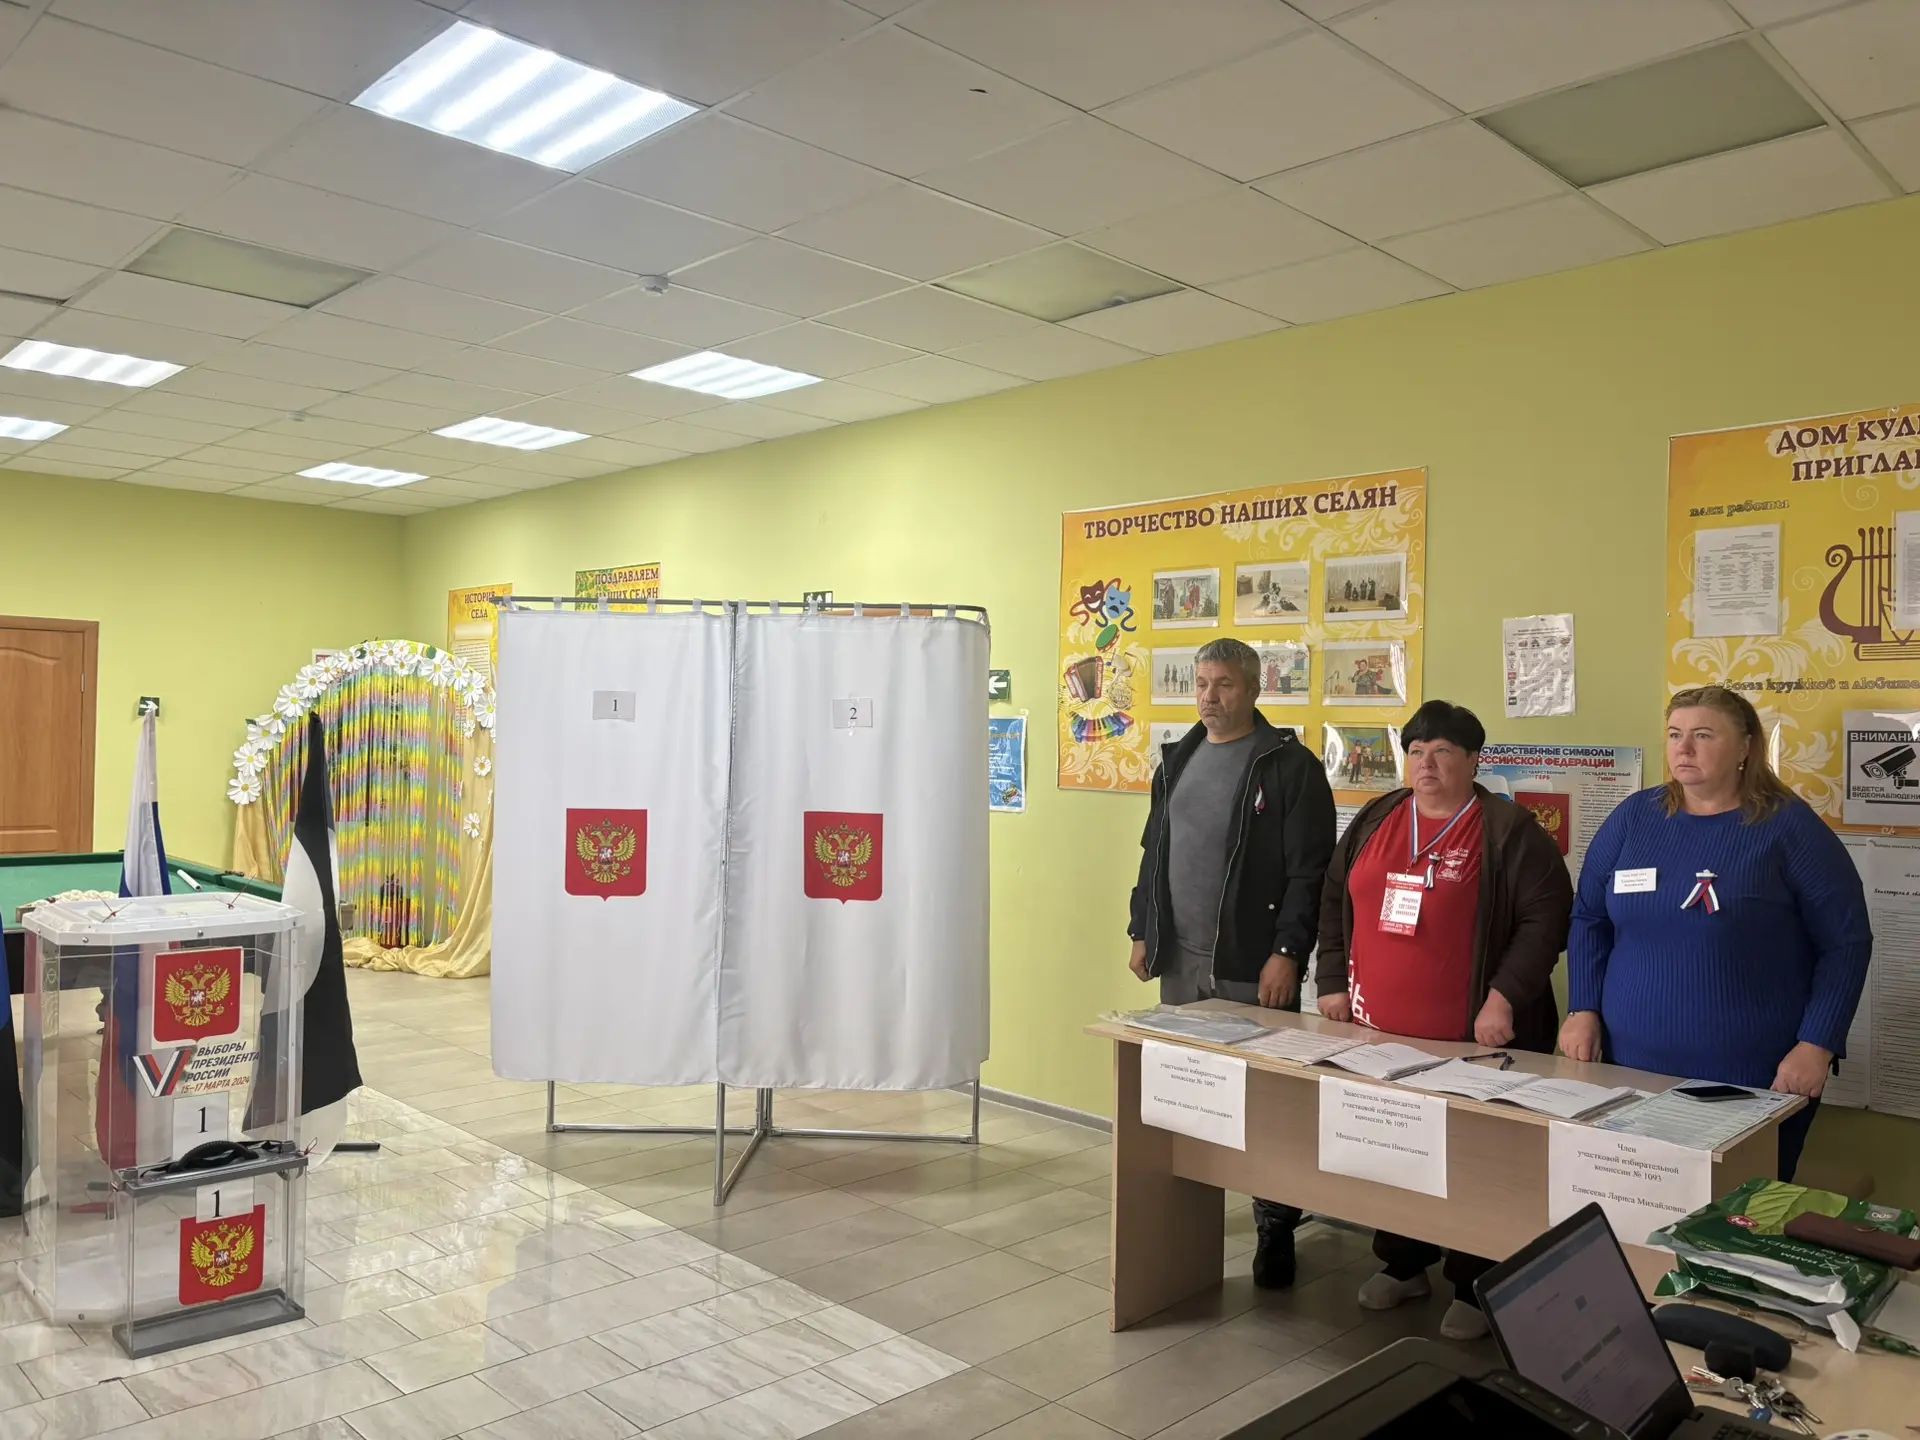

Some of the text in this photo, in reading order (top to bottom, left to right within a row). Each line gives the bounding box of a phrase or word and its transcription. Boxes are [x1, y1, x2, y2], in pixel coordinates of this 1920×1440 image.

[1776, 423, 1848, 454] ДОМ
[1084, 485, 1398, 539] ТВОРЧЕСТВО НАШИХ СЕЛЯН
[595, 568, 659, 585] ПОЗДРАВЛЯЕМ
[471, 608, 488, 619] СЕЛА
[612, 699, 618, 712] 1
[849, 707, 857, 720] 2
[1483, 746, 1614, 757] СУДАРСТВЕННЫЕ СИМВОЛЫ
[1478, 754, 1615, 768] ОССИЙСКОЙ ФЕДЕРАЦИИ
[1852, 792, 1920, 800] ВИДЕОНАБЛЮДЕНИ
[197, 1041, 246, 1057] ВЫБОРЫ
[191, 1051, 260, 1069] ПРЕЗИДЕНТА
[185, 1068, 231, 1083] РОССИИ
[204, 1079, 231, 1091] МАРТА
[231, 1076, 250, 1087] 2024
[1342, 1089, 1421, 1110] Заместитель председателя
[1342, 1101, 1376, 1113] участковой
[198, 1107, 208, 1133] 1
[1354, 1114, 1384, 1125] комиссии
[1617, 1143, 1637, 1153] Член
[1577, 1150, 1679, 1175] участковой избирательной
[1594, 1165, 1662, 1182] комиссии № 1093
[211, 1189, 222, 1218] 1
[1607, 1192, 1636, 1204] Лариса
[1637, 1197, 1687, 1214] Михайловна
